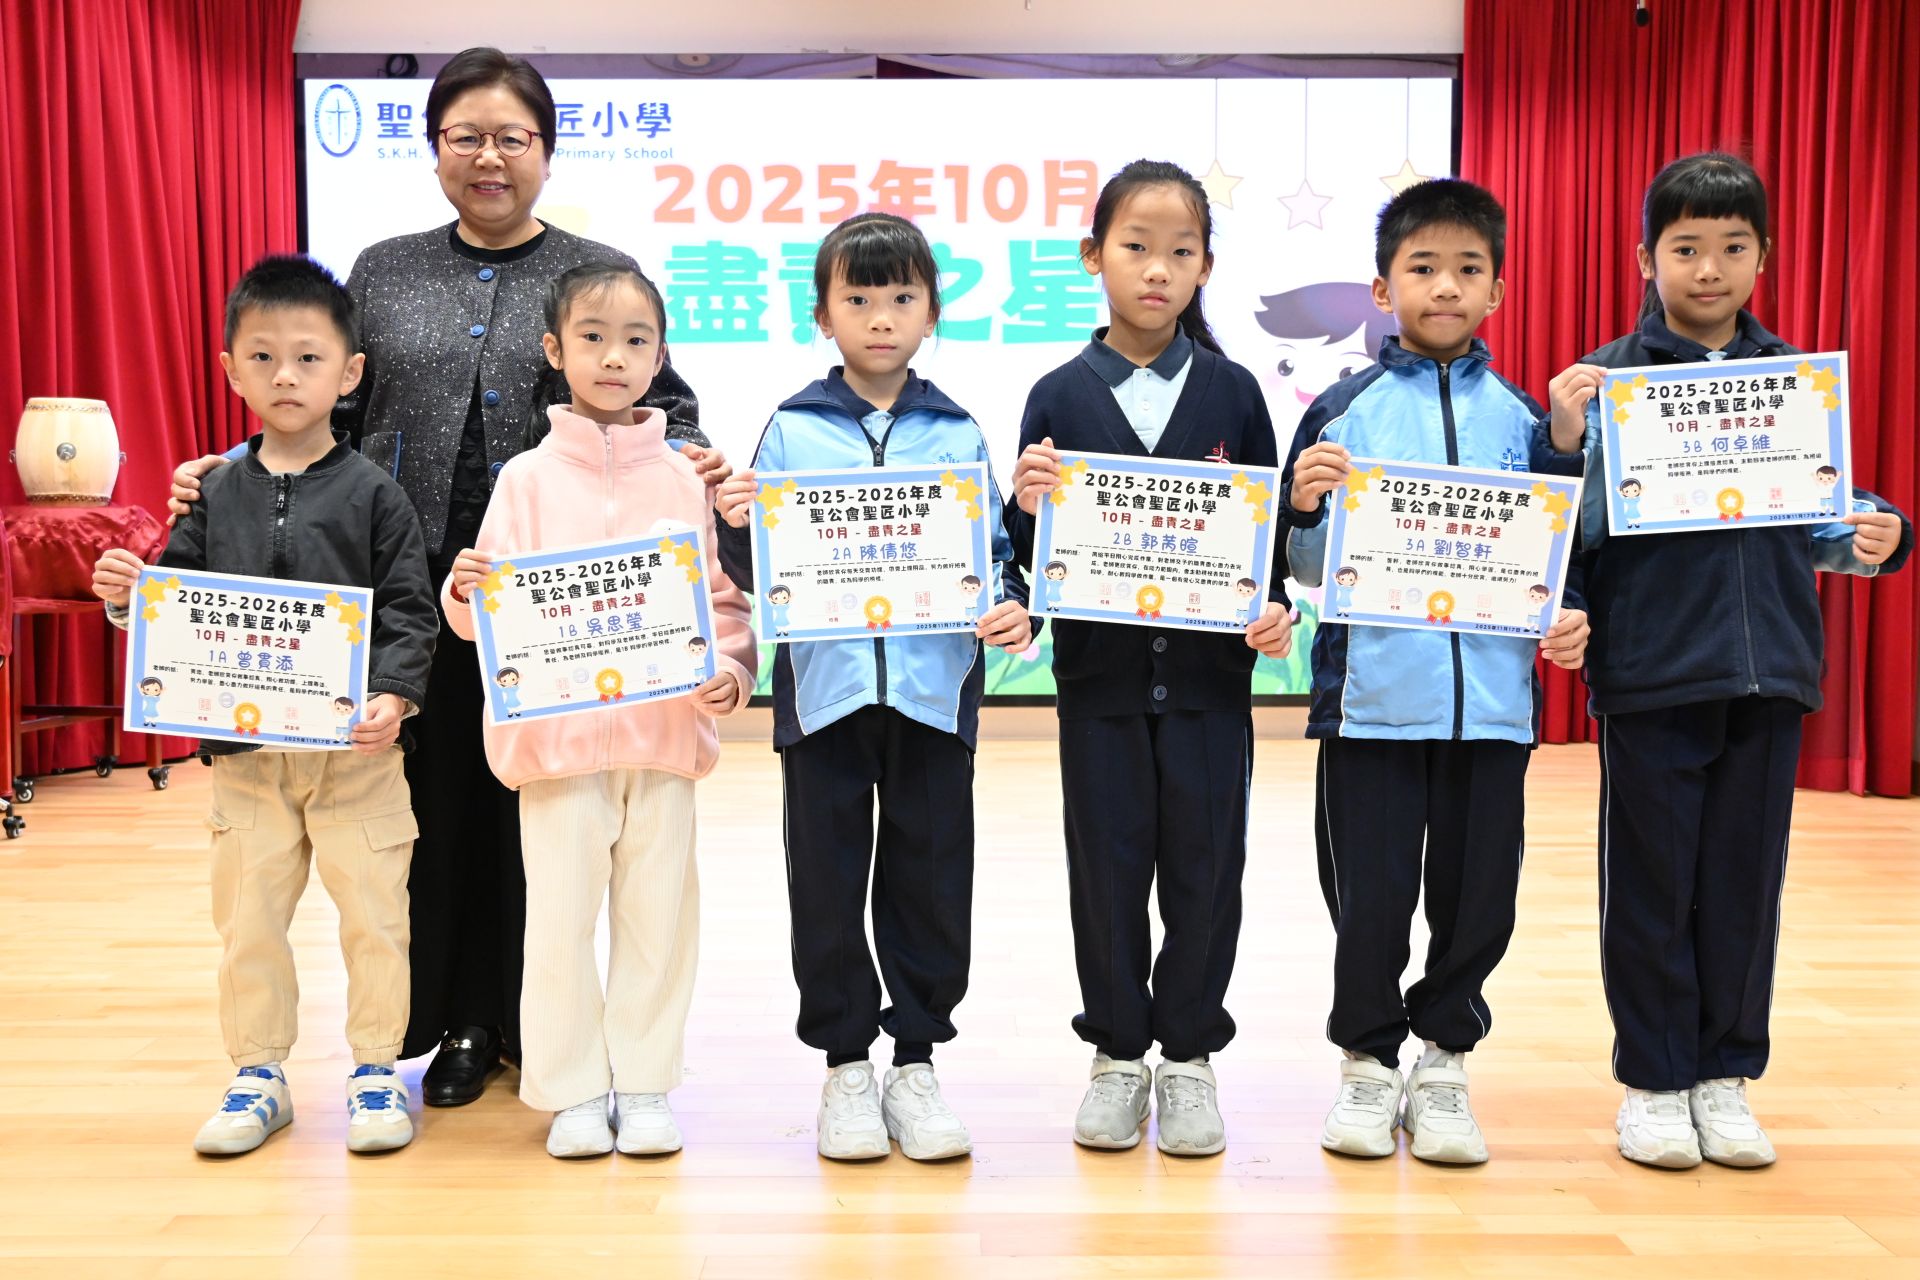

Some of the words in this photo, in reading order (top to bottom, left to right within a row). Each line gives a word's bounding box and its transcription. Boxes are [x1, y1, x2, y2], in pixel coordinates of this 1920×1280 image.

[378, 148, 423, 159] S.K.H.
[556, 148, 615, 161] Primary
[624, 148, 673, 158] School
[654, 159, 1098, 227] 2025年10月
[1646, 376, 1797, 400] 2025-2026年度
[1660, 395, 1784, 418] 聖公會聖匠小學
[1668, 420, 1698, 433] 10月
[1720, 415, 1775, 430] 盡責之星
[1683, 440, 1702, 453] 3B
[1711, 434, 1770, 452] 何卓維
[796, 485, 942, 505] 2025-2026年度
[1085, 473, 1232, 498] 2025-2026年度
[1380, 479, 1531, 507] 2025-2026年度
[810, 503, 930, 523] 聖公會聖匠小學
[1096, 491, 1217, 515] 聖公會聖匠小學
[1391, 497, 1514, 523] 聖公會聖匠小學
[818, 527, 847, 539] 10月
[868, 523, 922, 537] 盡責之星
[1102, 512, 1131, 524] 10月
[1152, 516, 1205, 531] 盡責之星
[1396, 518, 1425, 531] 10月
[1446, 523, 1500, 538] 盡責之星
[1113, 532, 1131, 545] 2B
[1406, 538, 1424, 551] 3A
[1434, 539, 1492, 559] 劉智軒
[833, 548, 851, 560] 2A
[860, 542, 917, 560] 陳倩悠
[515, 552, 663, 588] 2025-2026年度
[531, 572, 652, 604] 聖公會聖匠小學
[178, 590, 326, 618] 2025-2026年度
[541, 605, 571, 619] 10月
[592, 593, 646, 612] 盡責之星
[190, 608, 312, 634] 聖公會聖匠小學
[559, 625, 577, 638] 1B
[196, 629, 225, 642] 10月
[246, 634, 300, 650] 盡責之星
[210, 650, 226, 663] 1A
